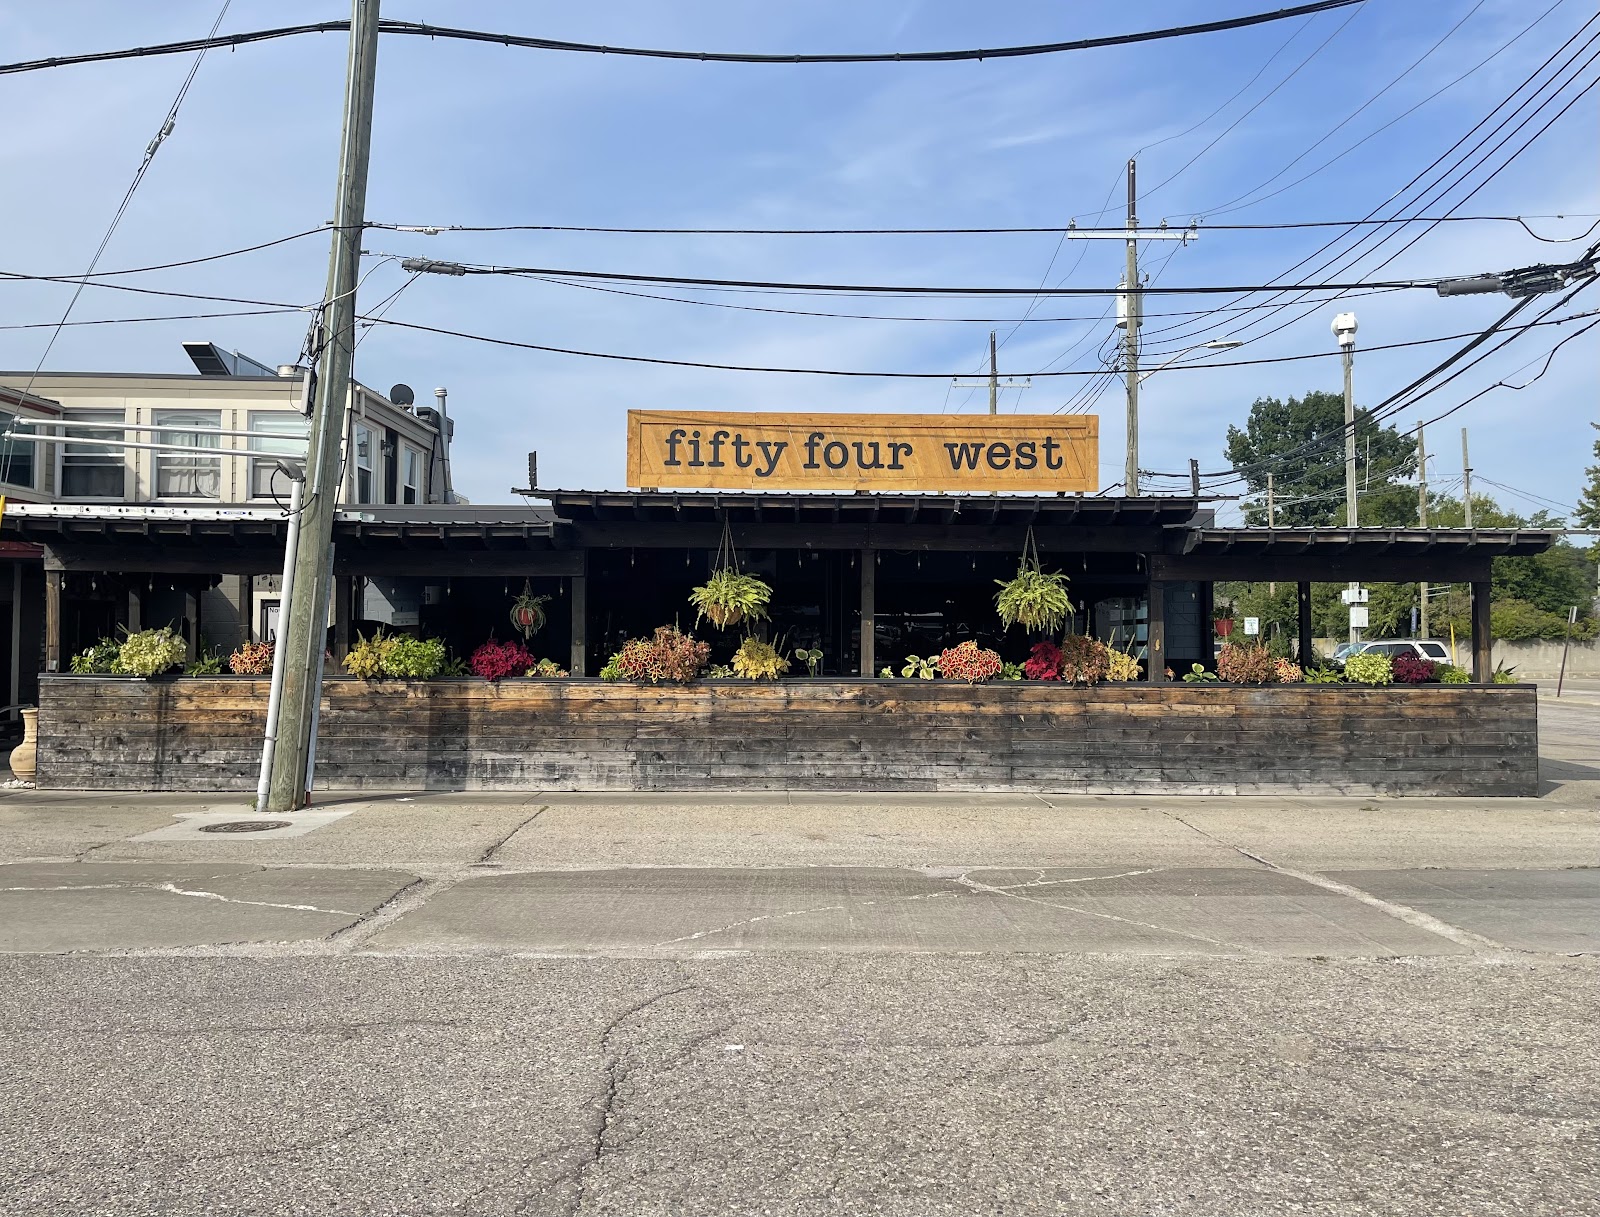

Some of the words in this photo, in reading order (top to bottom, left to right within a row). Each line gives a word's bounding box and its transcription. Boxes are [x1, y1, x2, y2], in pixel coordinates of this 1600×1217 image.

[664, 429, 788, 477] fifty
[803, 431, 913, 470] four
[944, 436, 1063, 470] west
